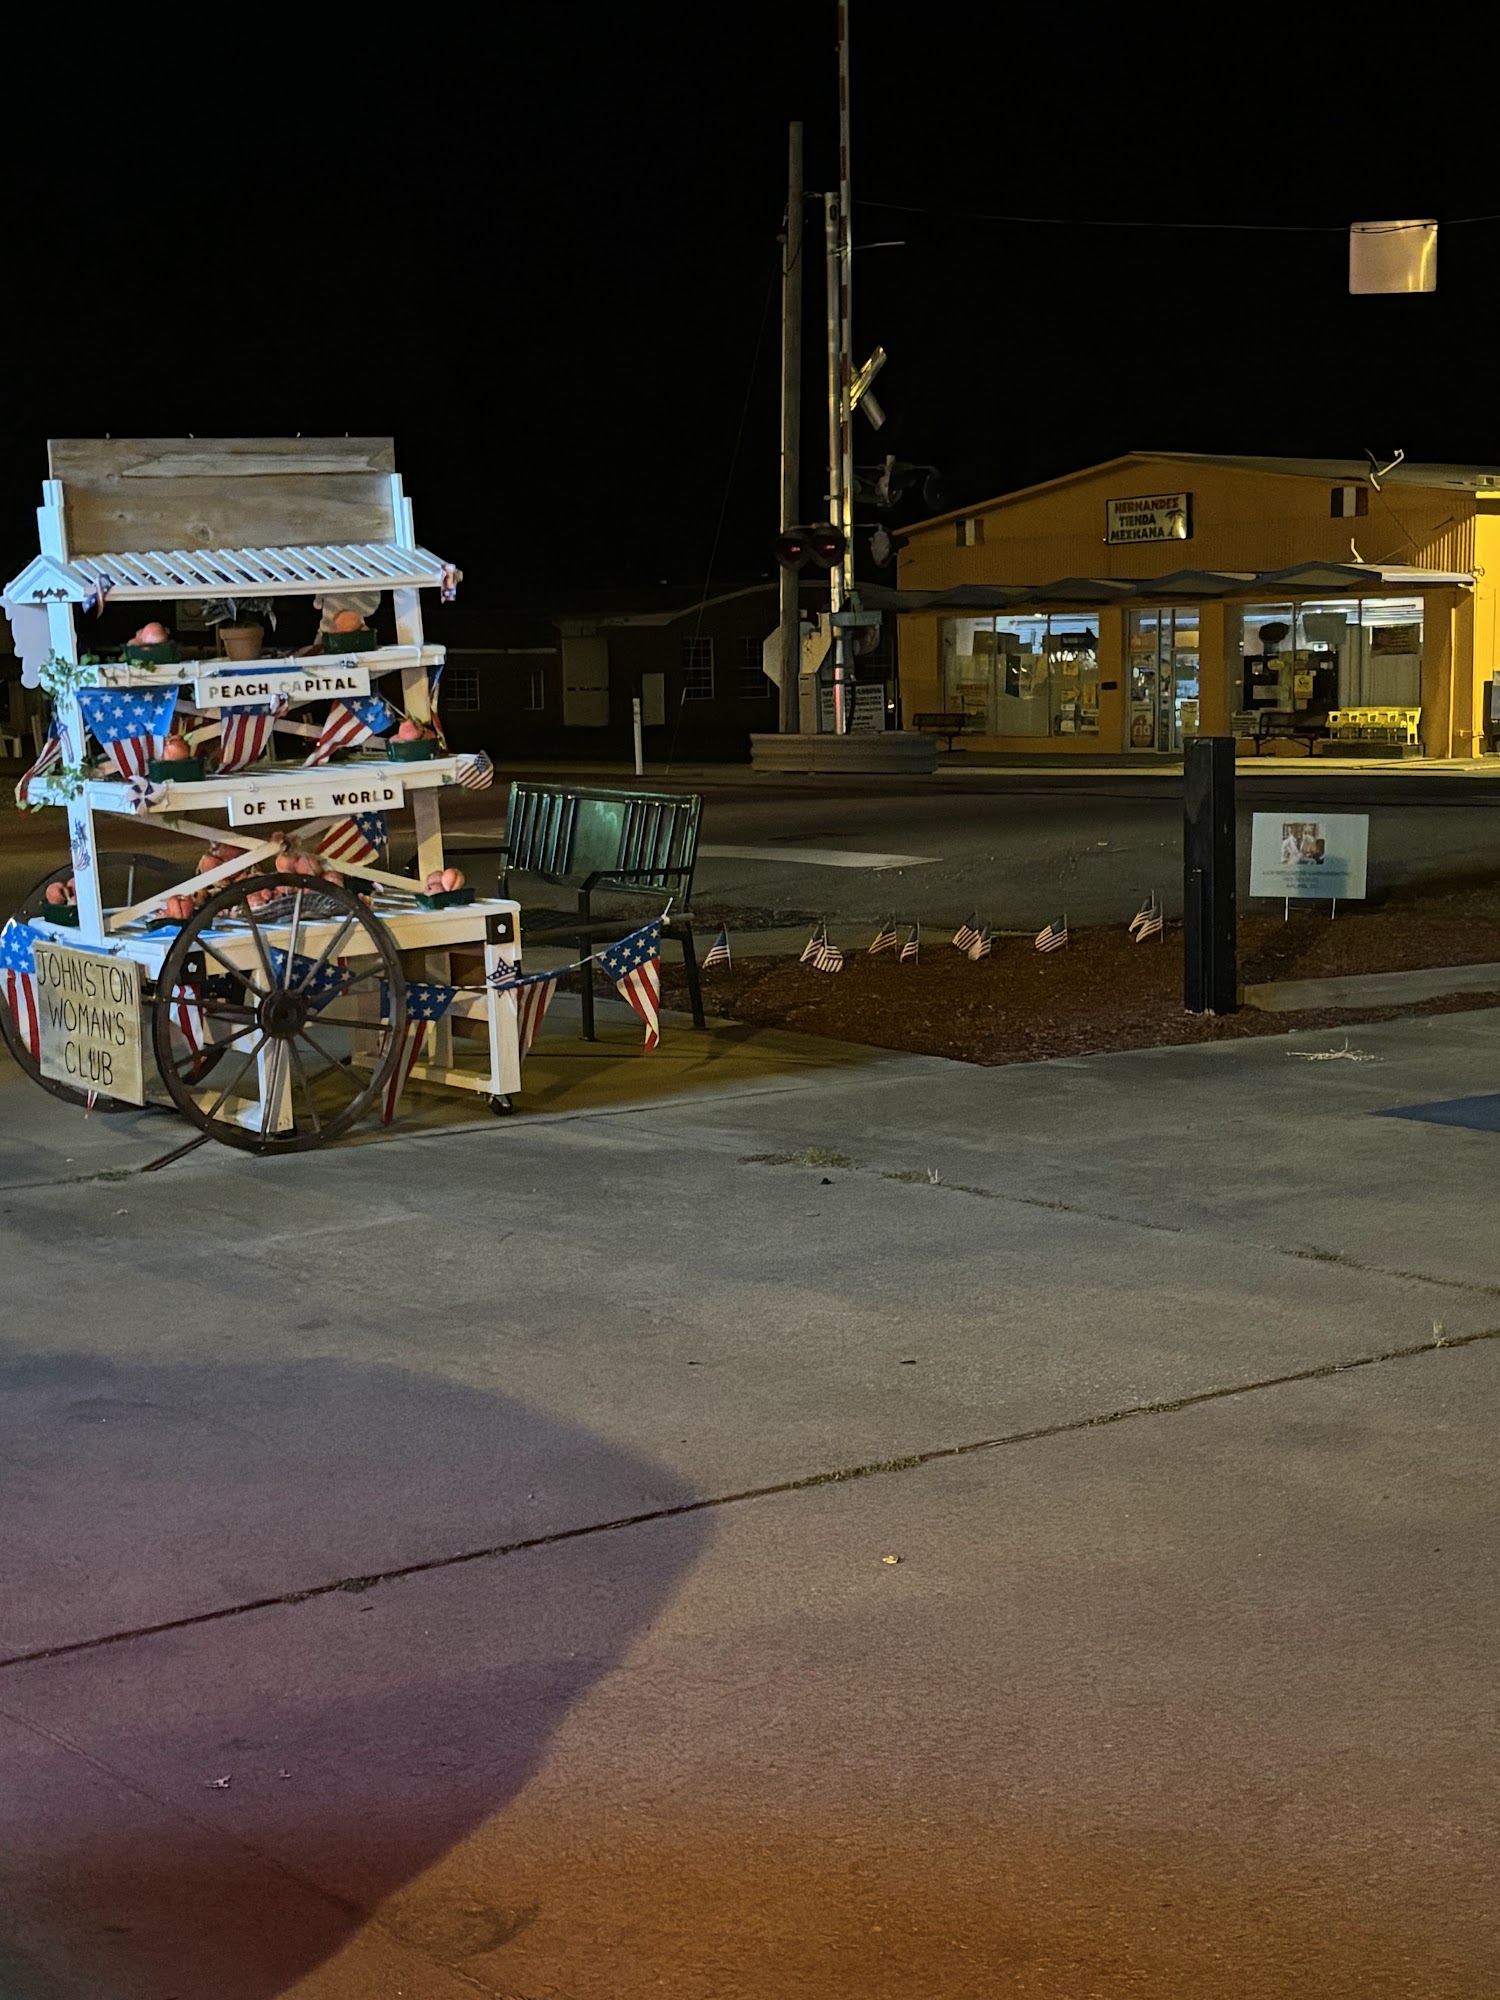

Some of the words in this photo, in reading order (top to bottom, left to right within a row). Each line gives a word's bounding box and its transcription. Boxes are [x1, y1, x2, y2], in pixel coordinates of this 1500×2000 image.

[1119, 514, 1156, 527] TIENDA
[209, 683, 269, 699] PEACH
[279, 677, 357, 694] CAPITAL
[243, 802, 267, 816] OF
[278, 798, 315, 812] THE
[332, 789, 394, 806] WORLD
[36, 950, 134, 1005] JOHNSTON
[48, 996, 126, 1046] WOMAN'S
[64, 1041, 113, 1086] CLUB
